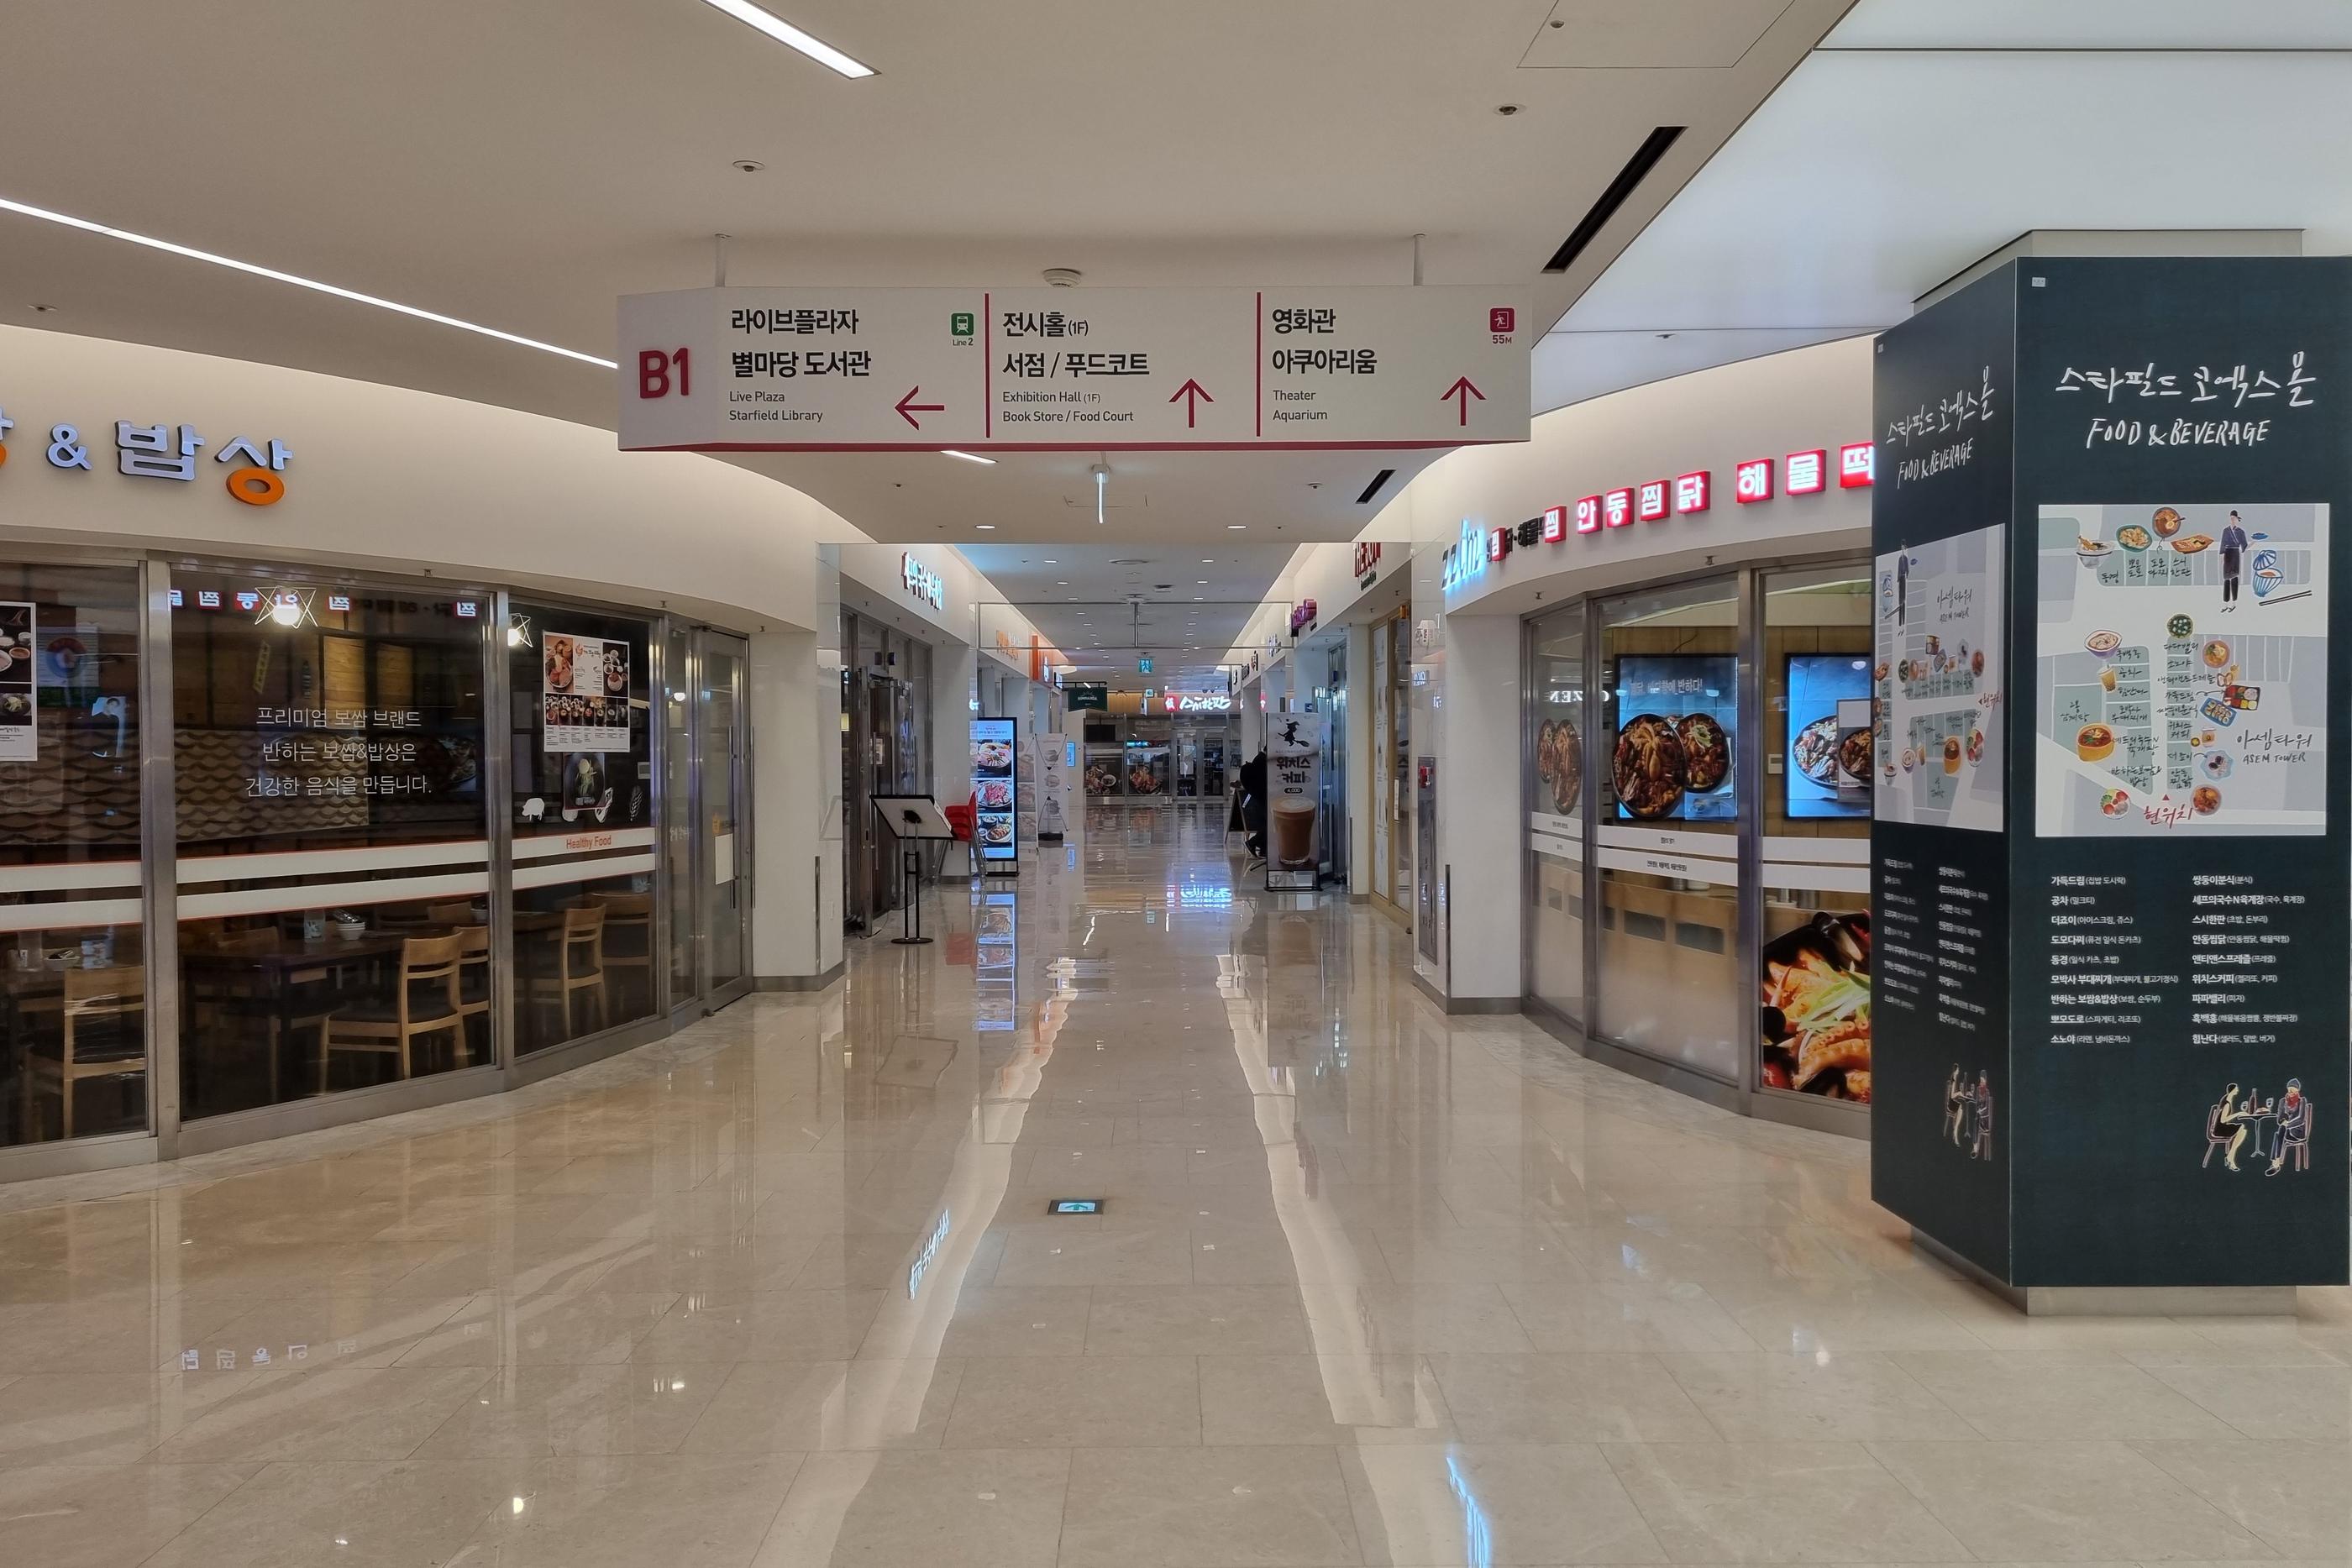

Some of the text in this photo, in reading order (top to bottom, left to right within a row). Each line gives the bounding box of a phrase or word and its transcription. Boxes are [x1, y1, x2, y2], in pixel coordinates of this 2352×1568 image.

[732, 308, 859, 334] 라이브플라자
[1002, 311, 1089, 338] 전시홀 (1F)
[1272, 308, 1336, 334] 영화관
[952, 337, 974, 346] Line 2
[1492, 334, 1512, 344] 55M
[639, 347, 690, 399] B1
[732, 350, 872, 378] 별마당 도서관
[1002, 352, 1045, 379] 서점
[1064, 353, 1150, 378] 푸드코트
[1272, 349, 1378, 375] 아쿠아리움
[2055, 362, 2183, 404] 스타필드
[729, 391, 785, 402] Live Plaza
[1002, 391, 1101, 404] Exhibition Hall (1F)
[1273, 390, 1316, 401] Theater
[729, 409, 823, 423] Starfield Library
[1002, 411, 1032, 422] Book
[1033, 411, 1063, 422] Store
[1073, 411, 1100, 422] Food
[1102, 411, 1135, 422] Court
[1273, 409, 1328, 423] Aquarium
[1886, 403, 1936, 448] 스타필드
[2086, 417, 2142, 449] FOOD
[2169, 417, 2271, 447] BEVERAGE
[46, 422, 92, 471] &
[114, 419, 294, 506] 밥상
[1577, 475, 1705, 534] 안동찜닭
[256, 707, 422, 729] 프리미엄 보쌈 브랜드
[2237, 727, 2313, 751] 아셈타워
[263, 742, 417, 762] 반하는 보쌈&밥상은
[1276, 756, 1311, 770] 위치스
[2243, 753, 2270, 764] ASEM
[245, 775, 433, 797] 건강한 음식을 만듭니다.
[1281, 771, 1305, 784] 커피
[2143, 803, 2194, 830] 현위치
[566, 835, 612, 850] Healthy Food
[2050, 895, 2069, 906] 공차
[2192, 915, 2226, 925] 스시한판
